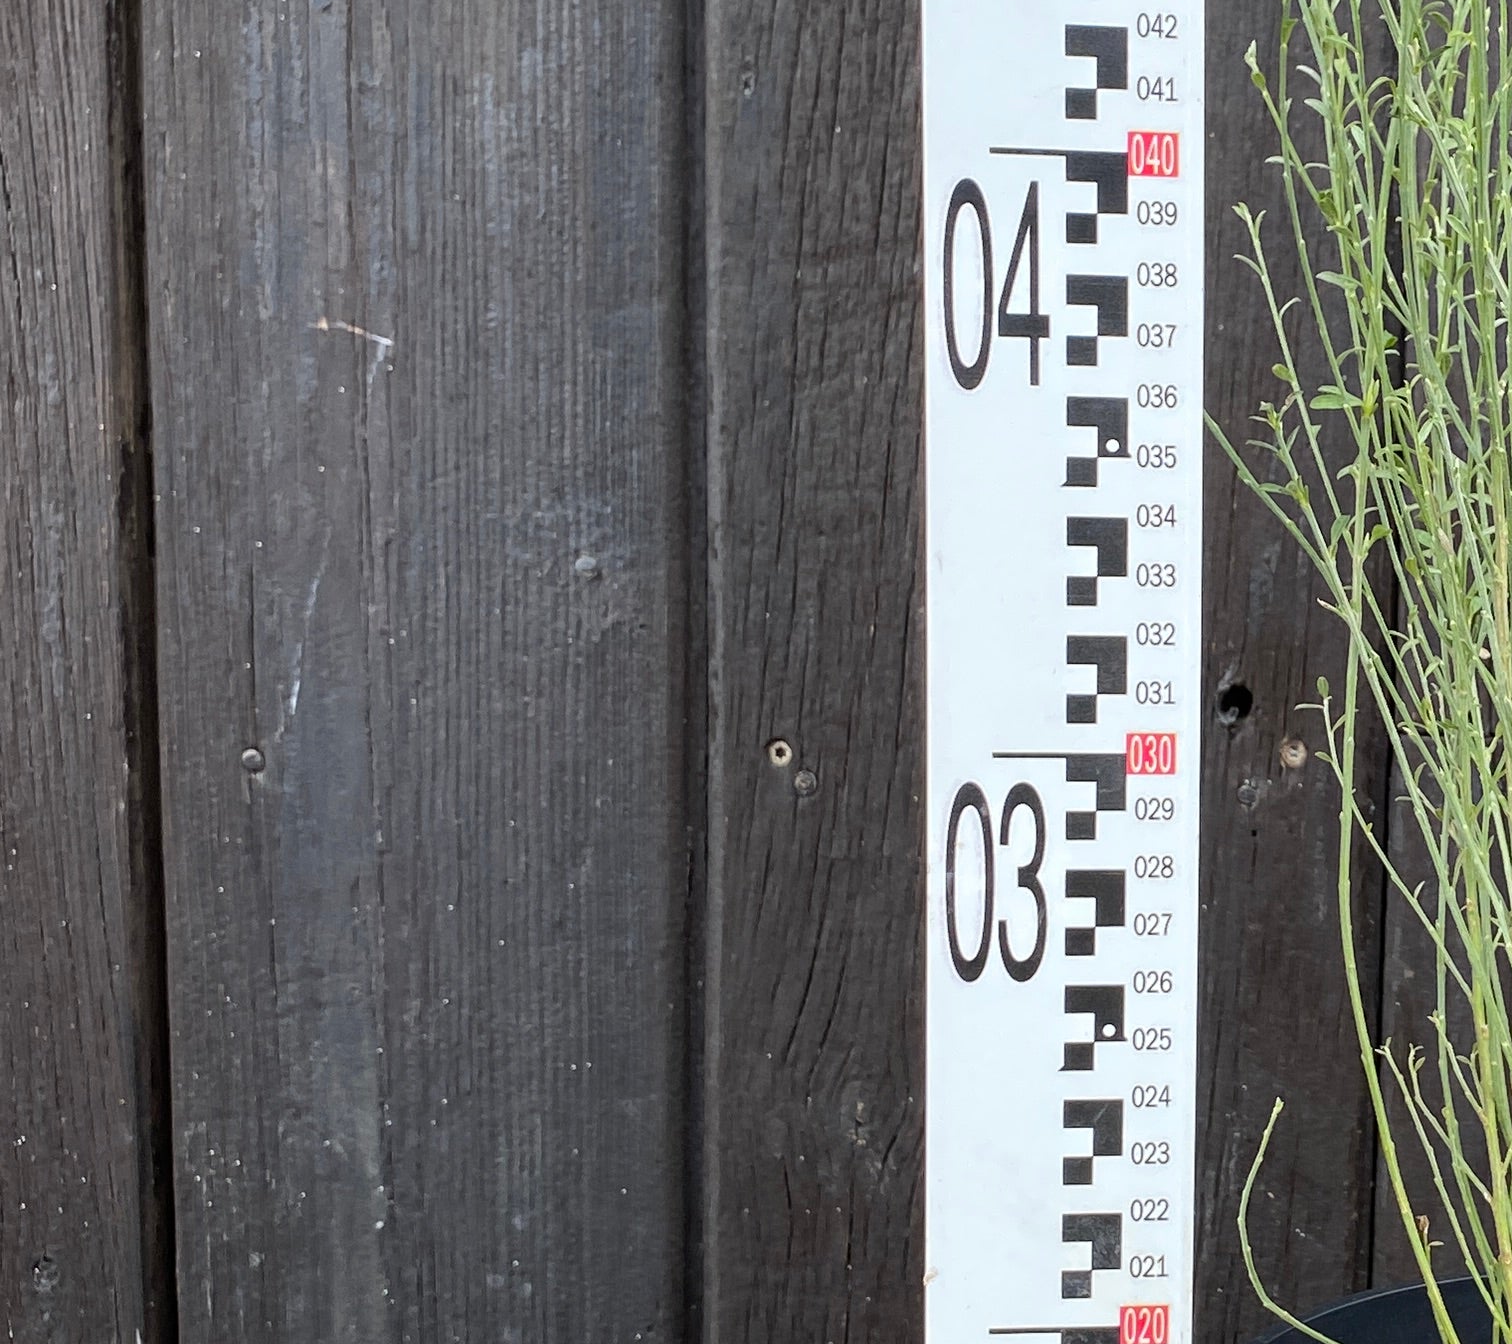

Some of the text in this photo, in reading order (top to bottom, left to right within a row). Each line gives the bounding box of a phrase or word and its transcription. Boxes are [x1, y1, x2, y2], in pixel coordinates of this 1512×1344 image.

[1137, 13, 1177, 38] 042
[1137, 76, 1178, 101] 041
[1132, 134, 1174, 175] 040
[1137, 201, 1177, 226] 039
[943, 178, 1050, 390] 04
[1137, 263, 1177, 287] 038
[1137, 323, 1176, 347] 037
[1137, 384, 1177, 408] 036
[1137, 445, 1176, 468] 035
[1137, 504, 1176, 527] 034
[1137, 563, 1175, 587] 033
[1136, 623, 1175, 645] 032
[1136, 681, 1175, 704] 031
[1131, 735, 1171, 773] 030
[1135, 798, 1174, 820] 029
[1135, 856, 1173, 878] 028
[946, 782, 1047, 982] 03
[1134, 914, 1172, 936] 027
[1134, 971, 1172, 993] 026
[1133, 1028, 1171, 1050] 025
[1132, 1085, 1171, 1108] 024
[1131, 1142, 1169, 1165] 023
[1131, 1199, 1168, 1221] 022
[1130, 1255, 1168, 1278] 021
[1124, 1308, 1165, 1344] 020
